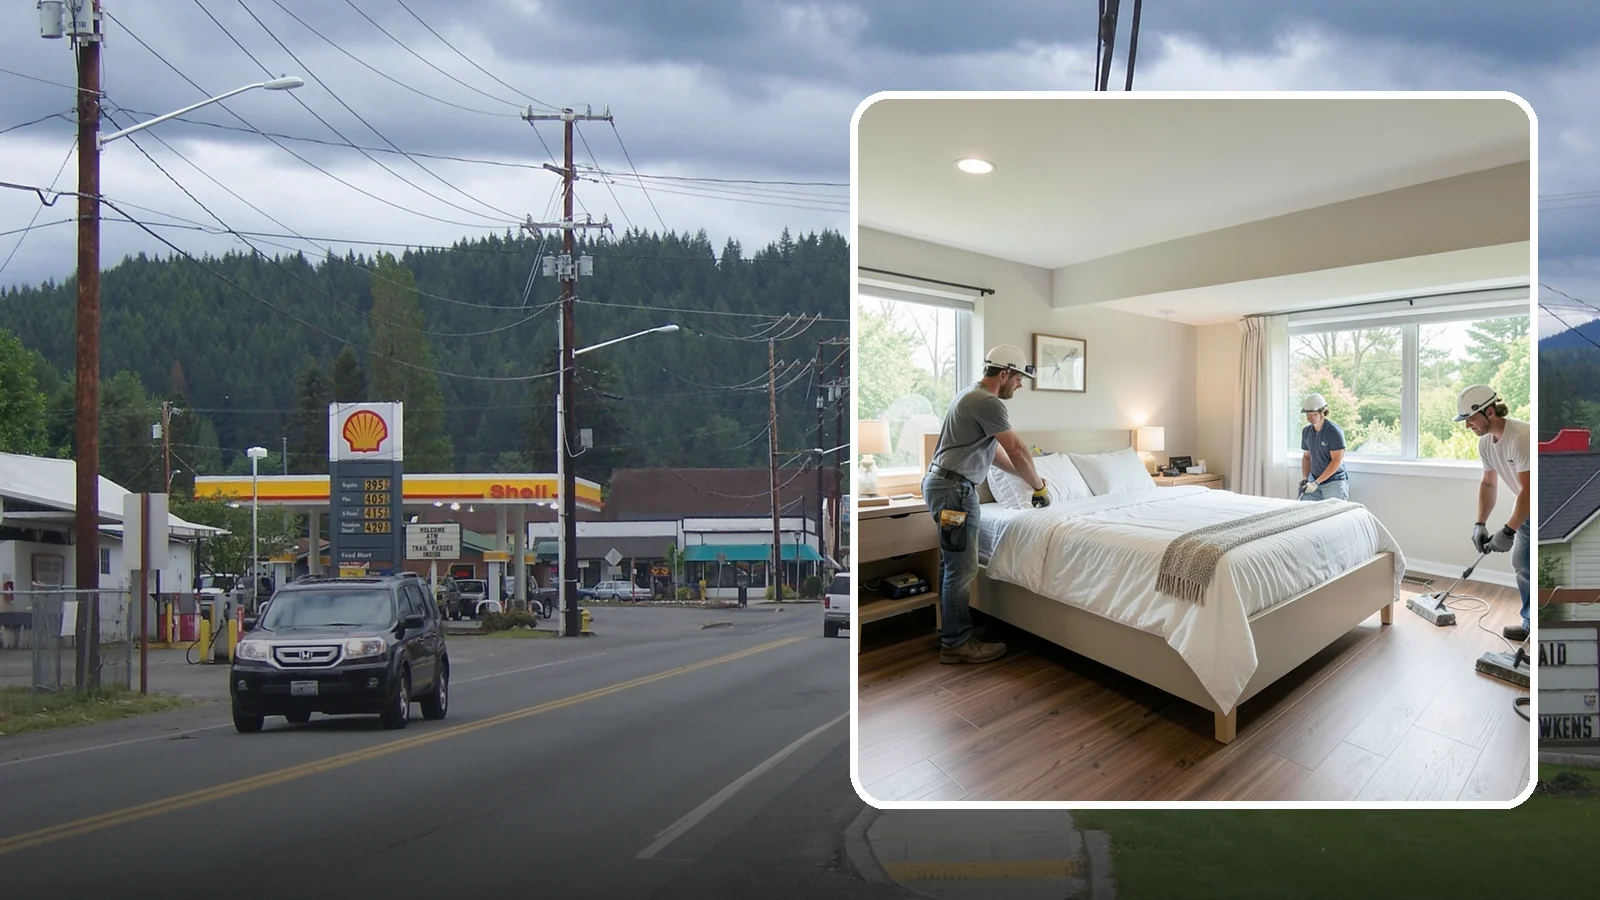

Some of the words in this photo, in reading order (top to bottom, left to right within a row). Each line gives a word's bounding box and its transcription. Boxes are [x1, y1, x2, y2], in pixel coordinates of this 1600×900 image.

[366, 480, 384, 490] 395
[490, 484, 547, 499] Shell
[366, 494, 384, 504] 405
[366, 508, 384, 518] 415
[366, 522, 384, 532] 429
[1538, 643, 1566, 665] AID
